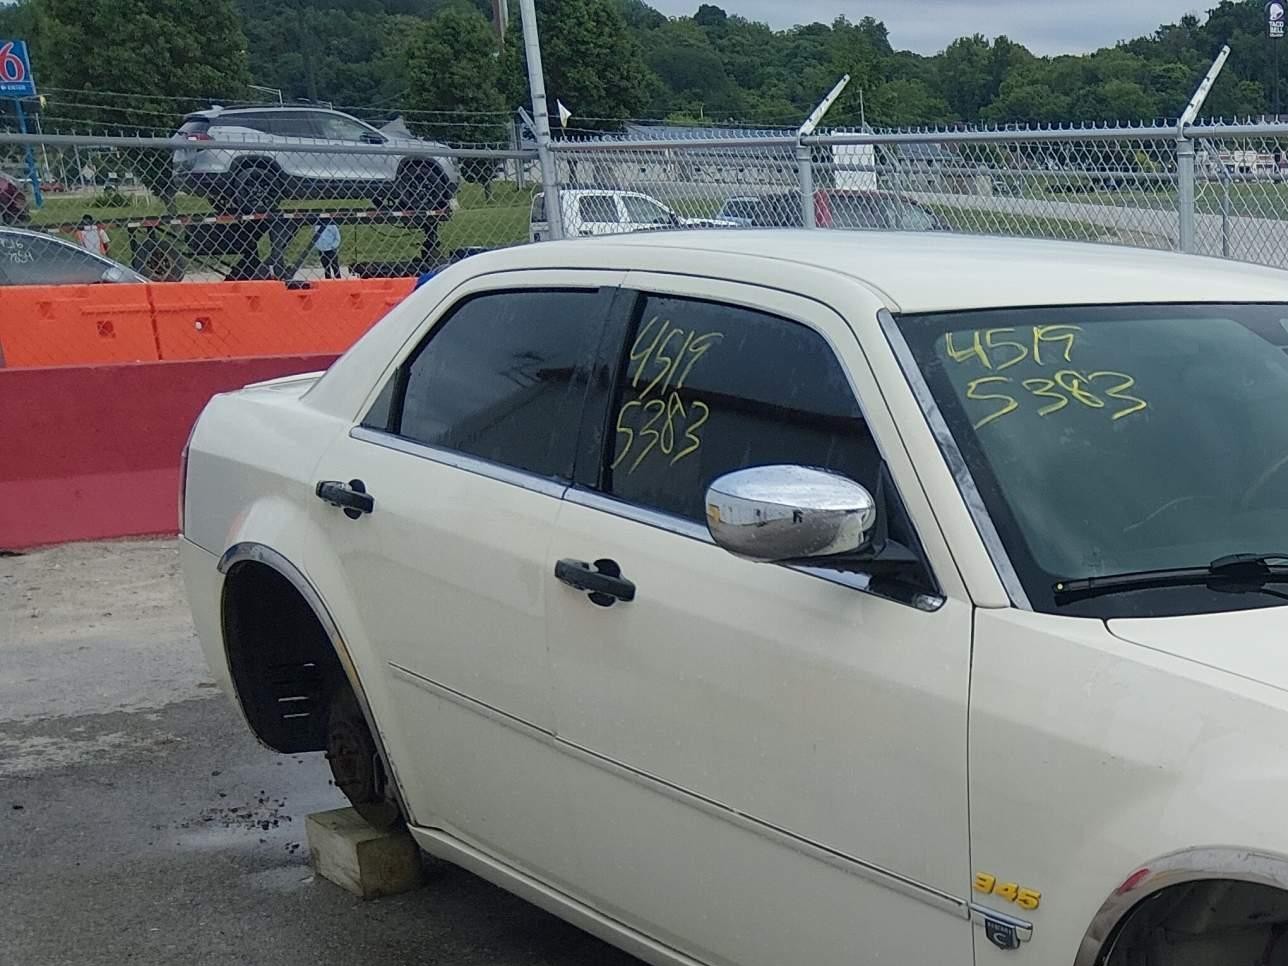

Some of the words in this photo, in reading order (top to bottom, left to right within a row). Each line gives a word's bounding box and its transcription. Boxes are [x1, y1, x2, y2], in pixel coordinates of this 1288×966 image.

[0, 42, 25, 82] 6
[630, 316, 724, 399] 4519
[944, 324, 1083, 369] 4519
[967, 370, 1148, 430] 5383
[611, 392, 709, 474] 5383
[974, 871, 1042, 910] 345
